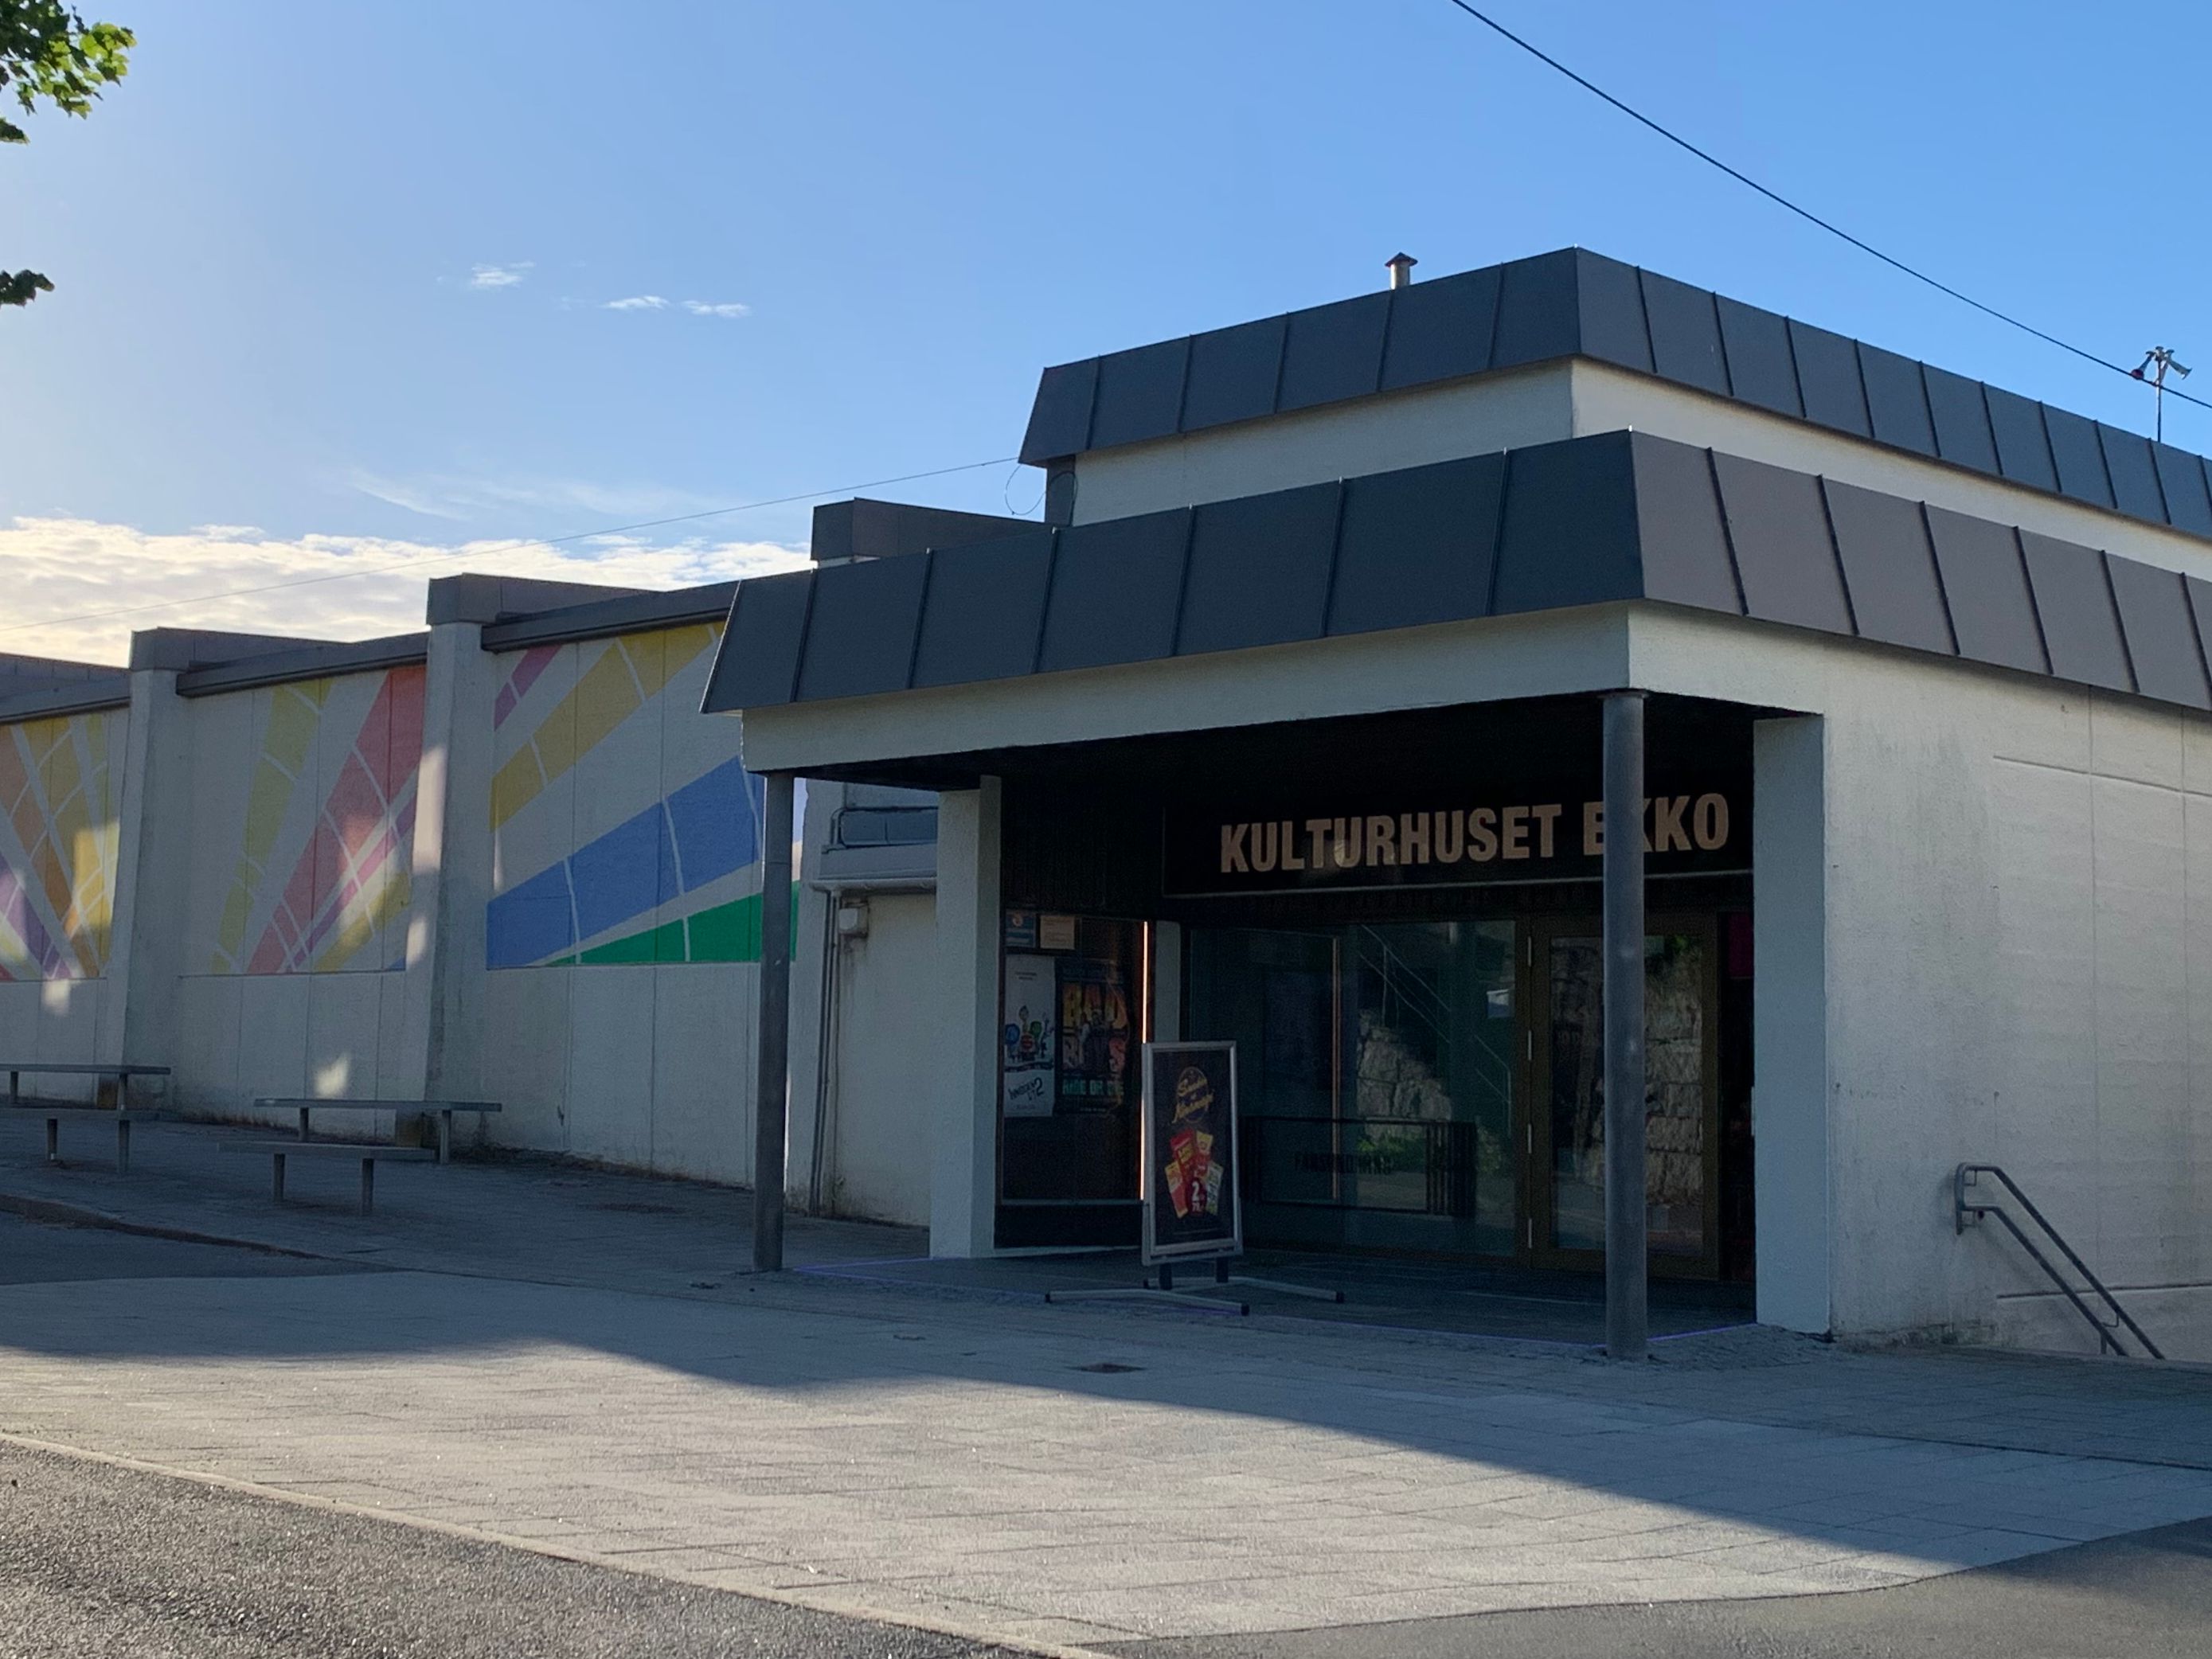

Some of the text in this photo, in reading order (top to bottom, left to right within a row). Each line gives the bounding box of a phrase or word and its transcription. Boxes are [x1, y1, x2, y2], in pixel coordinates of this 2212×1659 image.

[1220, 793, 1729, 873] KULTURHUSET EKO
[1034, 1075, 1045, 1097] 2
[1192, 1181, 1199, 1201] 2
